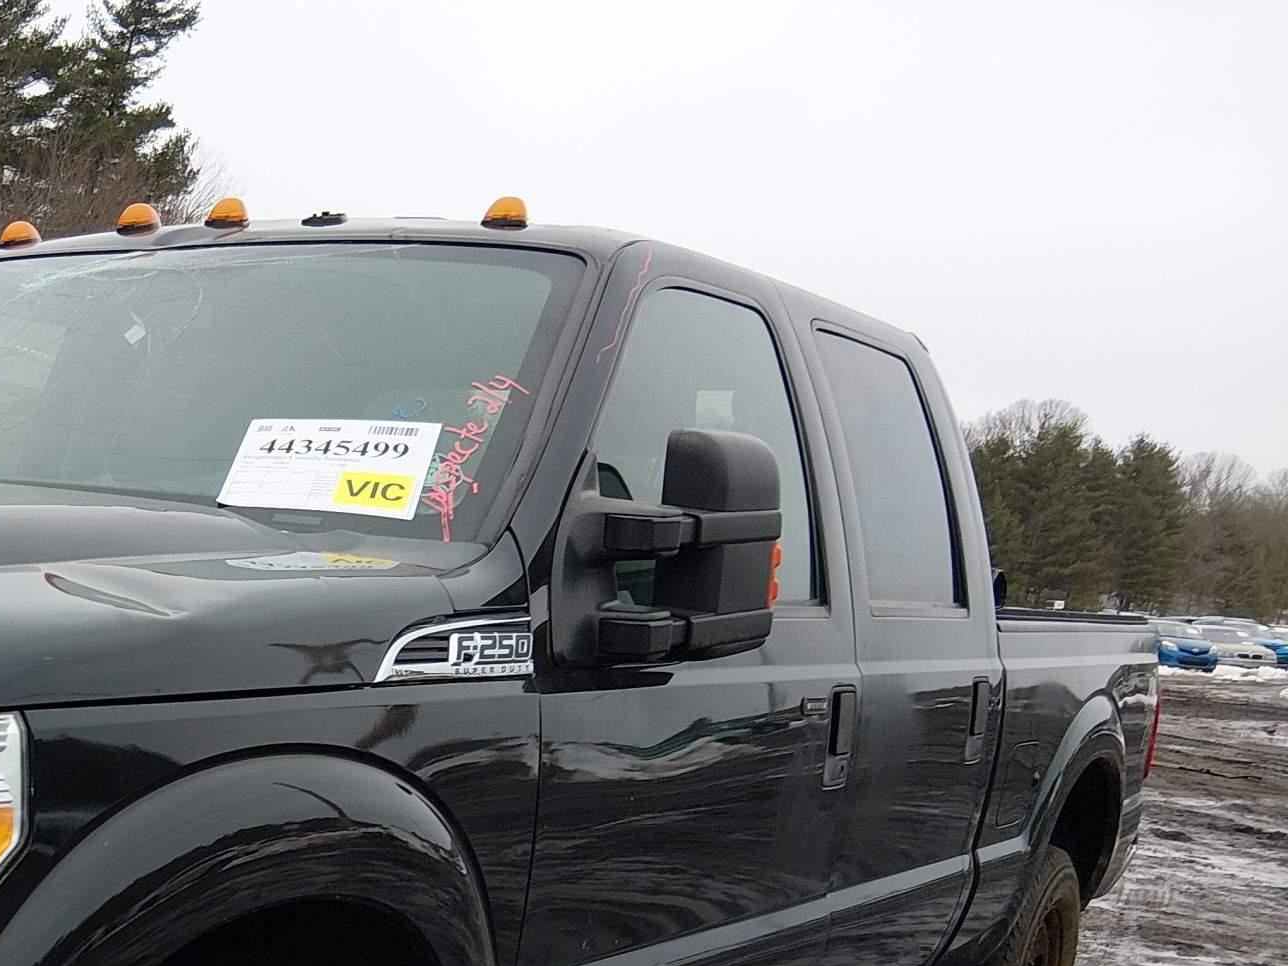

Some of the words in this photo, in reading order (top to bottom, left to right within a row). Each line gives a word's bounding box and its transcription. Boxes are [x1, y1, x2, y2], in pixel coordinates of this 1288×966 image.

[259, 438, 409, 460] 44345499
[345, 479, 406, 501] VIC
[453, 632, 532, 662] F-250
[454, 666, 495, 677] SUPER
[500, 665, 531, 674] DUTY
